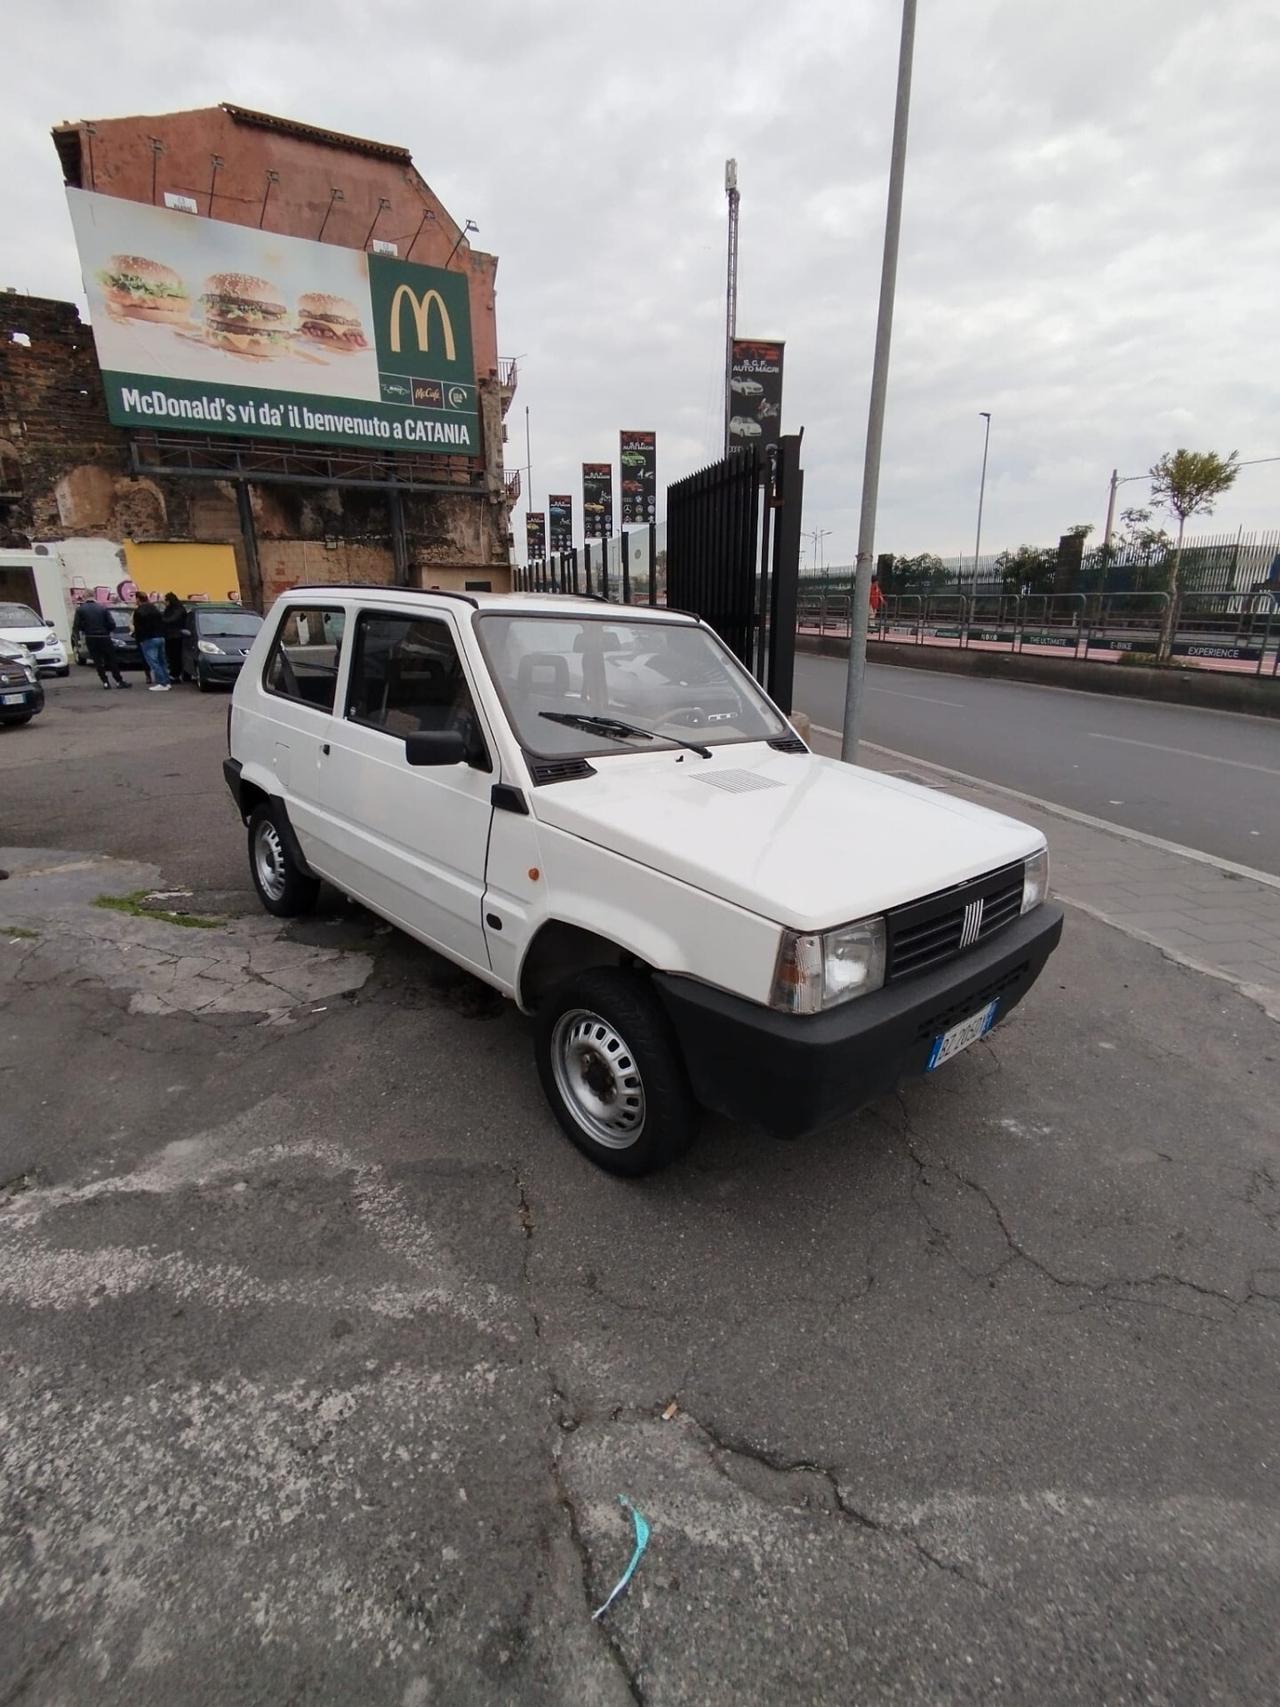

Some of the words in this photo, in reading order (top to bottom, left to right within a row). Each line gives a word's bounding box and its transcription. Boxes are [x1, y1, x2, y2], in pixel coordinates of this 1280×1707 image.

[121, 387, 237, 423] McDonald's
[238, 401, 256, 424] vi
[288, 405, 301, 428] il
[303, 407, 390, 438] benvenuto
[393, 422, 402, 439] a
[404, 418, 471, 446] CATANIA
[1110, 641, 1133, 650] E-BIKE
[1187, 646, 1240, 658] EXPERIENCE
